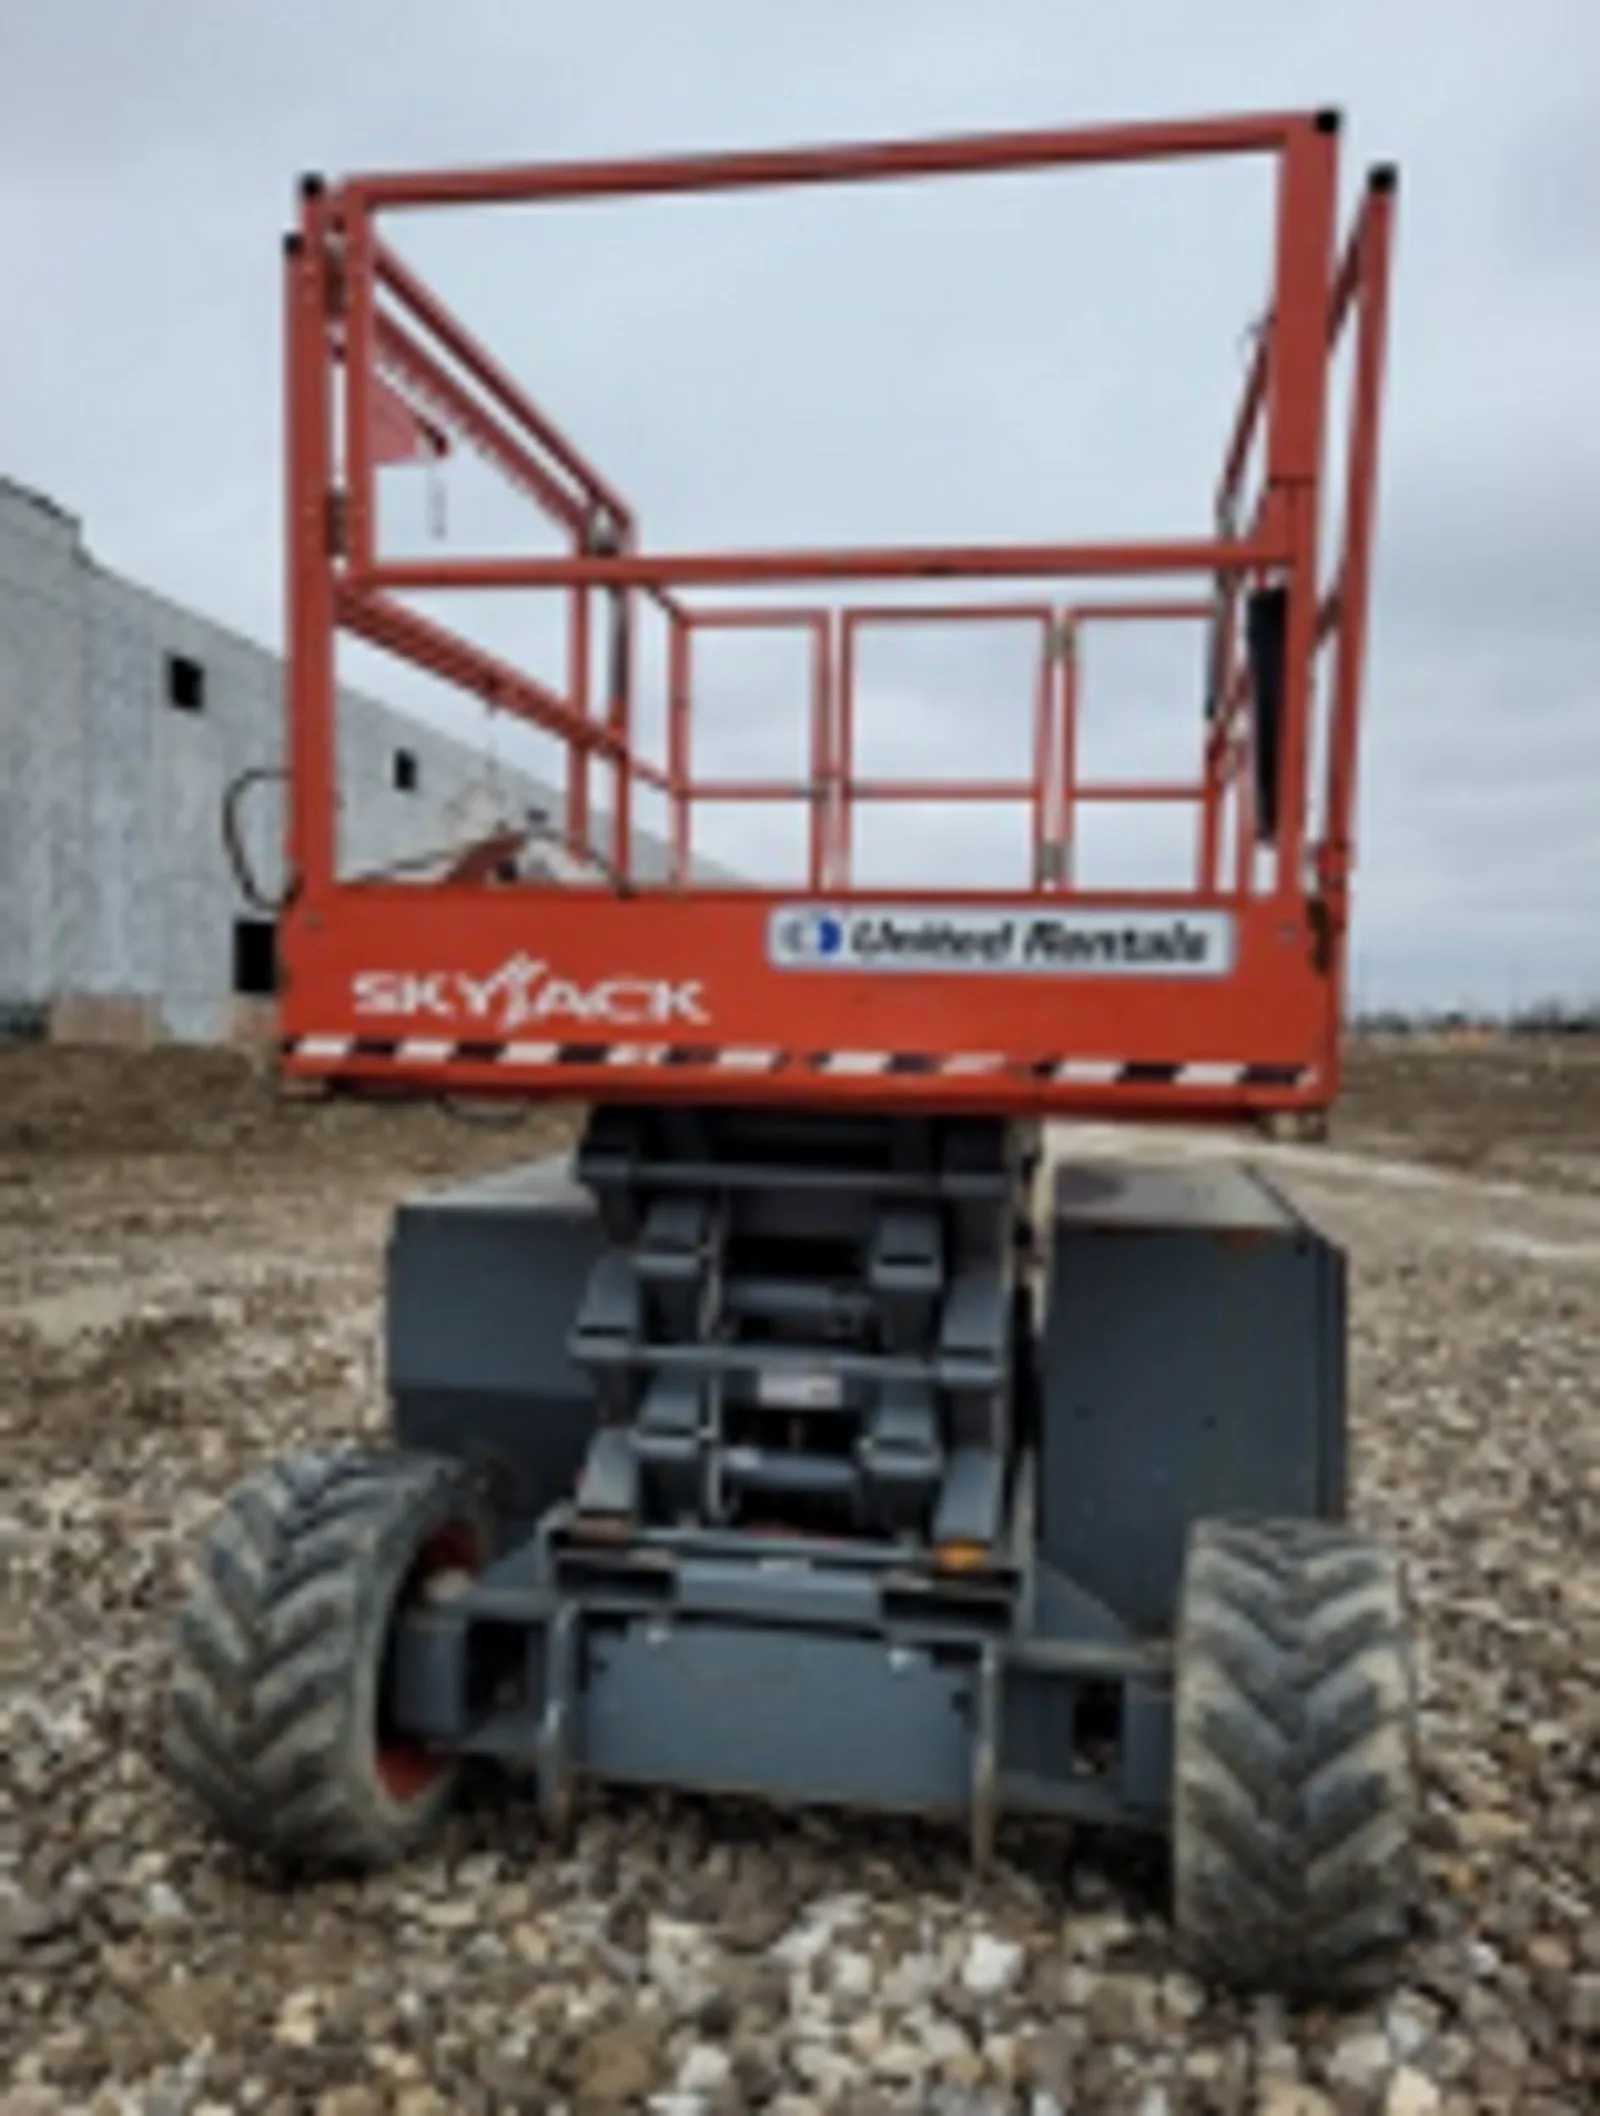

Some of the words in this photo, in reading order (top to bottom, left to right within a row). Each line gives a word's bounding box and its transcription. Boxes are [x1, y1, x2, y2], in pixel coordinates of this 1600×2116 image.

[849, 918, 1013, 961] United
[1023, 920, 1207, 963] Rentals
[351, 951, 711, 1032] SKYJACK
